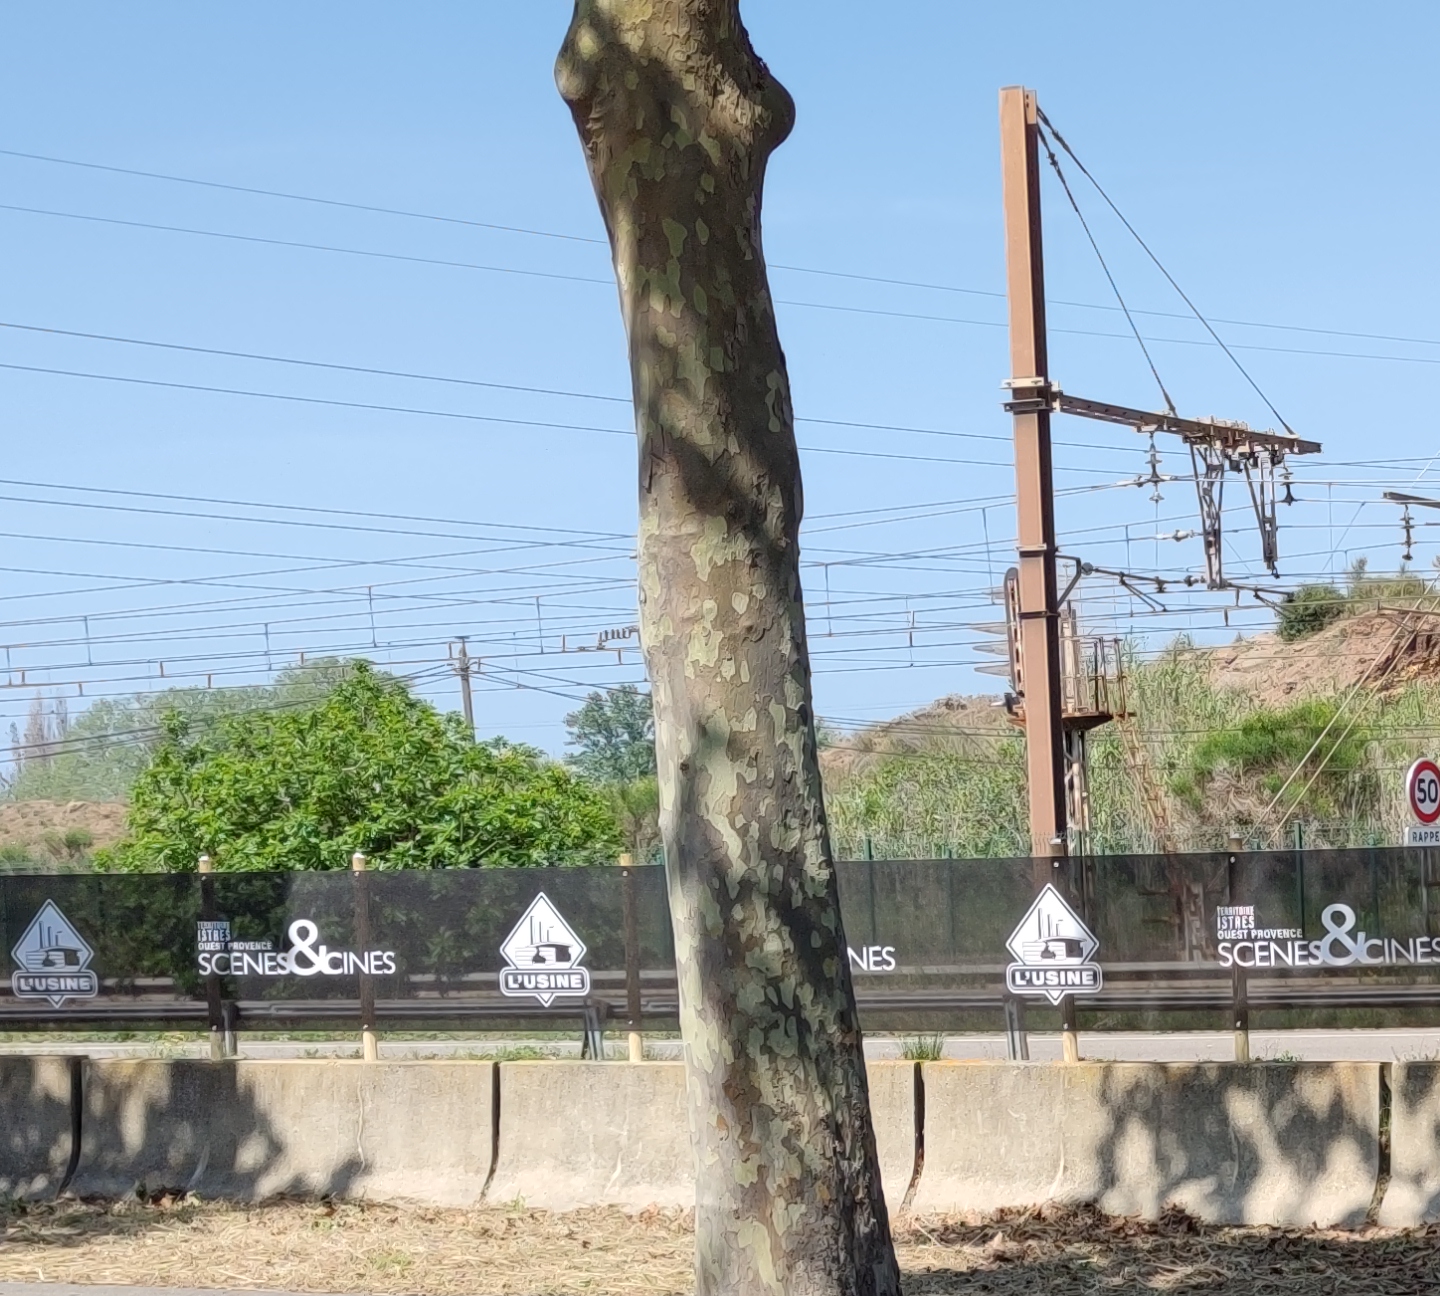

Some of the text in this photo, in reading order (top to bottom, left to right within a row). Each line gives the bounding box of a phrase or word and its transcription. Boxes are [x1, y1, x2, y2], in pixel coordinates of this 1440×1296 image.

[1417, 778, 1438, 803] 50
[1217, 915, 1255, 929] ISTRES
[197, 929, 231, 942] ISTRES
[1217, 928, 1303, 940] OUEST PROVENCE
[198, 940, 273, 951] OUEST PROVENCE
[19, 976, 91, 992] L'USINE
[507, 973, 582, 989] L'USINE
[1014, 970, 1095, 986] L'USINE
